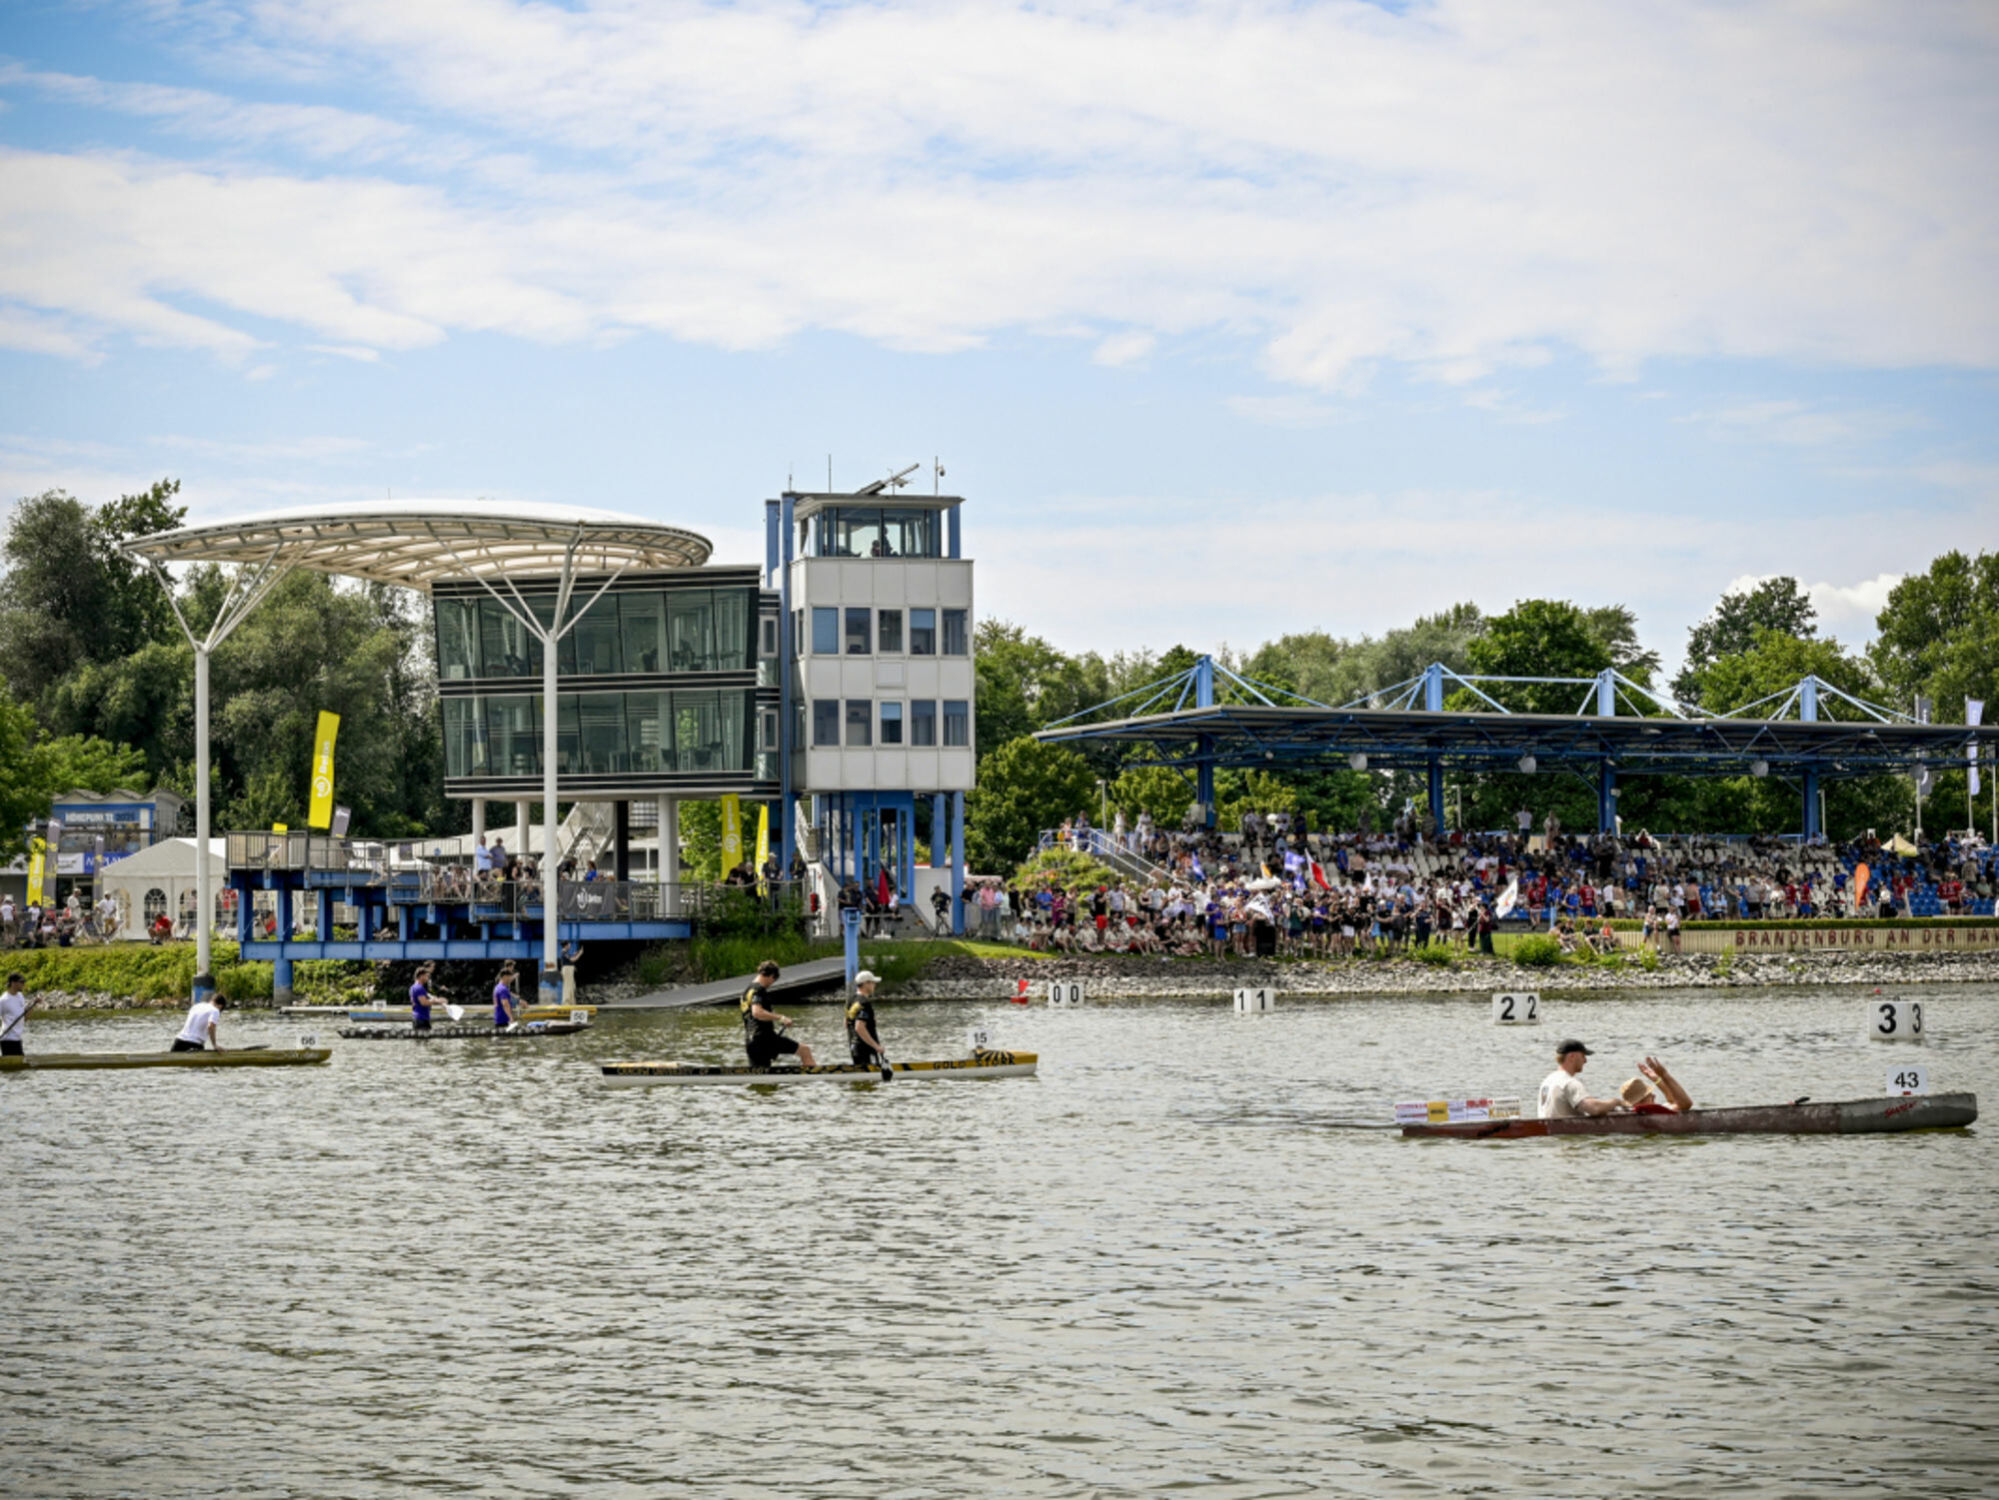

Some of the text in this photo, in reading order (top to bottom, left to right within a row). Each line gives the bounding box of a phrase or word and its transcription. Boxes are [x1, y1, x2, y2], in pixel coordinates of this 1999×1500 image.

[1736, 930, 1875, 946] BRANDENBURG
[1887, 929, 1910, 944] AN
[1922, 929, 1956, 944] DER
[1053, 985, 1061, 1003] 0
[1070, 985, 1079, 1003] 0
[1238, 990, 1245, 1011] 1
[1256, 990, 1265, 1011] 1
[1500, 995, 1515, 1020] 2
[1527, 995, 1536, 1020] 2
[1878, 1003, 1897, 1034] 3
[1912, 1003, 1921, 1034] 3
[974, 1032, 988, 1043] 15
[933, 1060, 967, 1071] GOLD
[1894, 1072, 1920, 1088] 43
